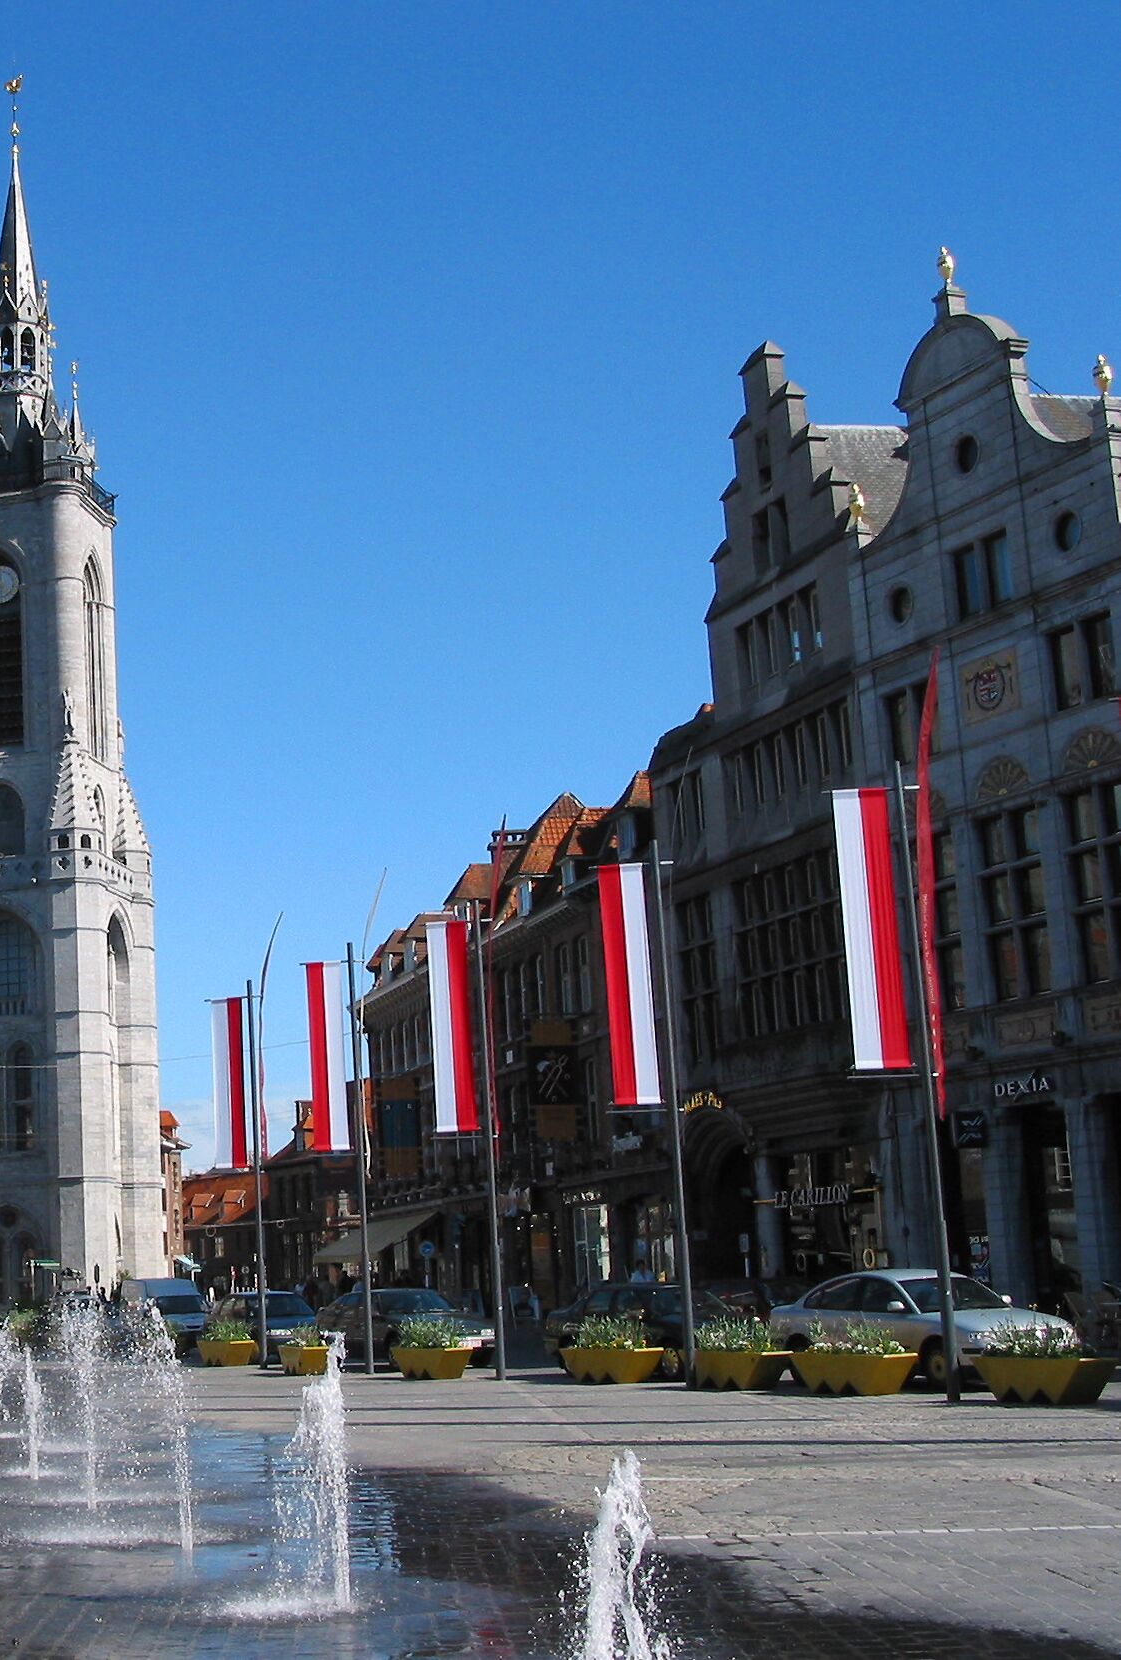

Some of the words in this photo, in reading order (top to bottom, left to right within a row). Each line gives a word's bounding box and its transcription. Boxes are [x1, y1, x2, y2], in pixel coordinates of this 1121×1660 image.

[994, 1070, 1050, 1100] DEXIA
[774, 1190, 788, 1208] LE
[790, 1184, 850, 1207] CARILLON
